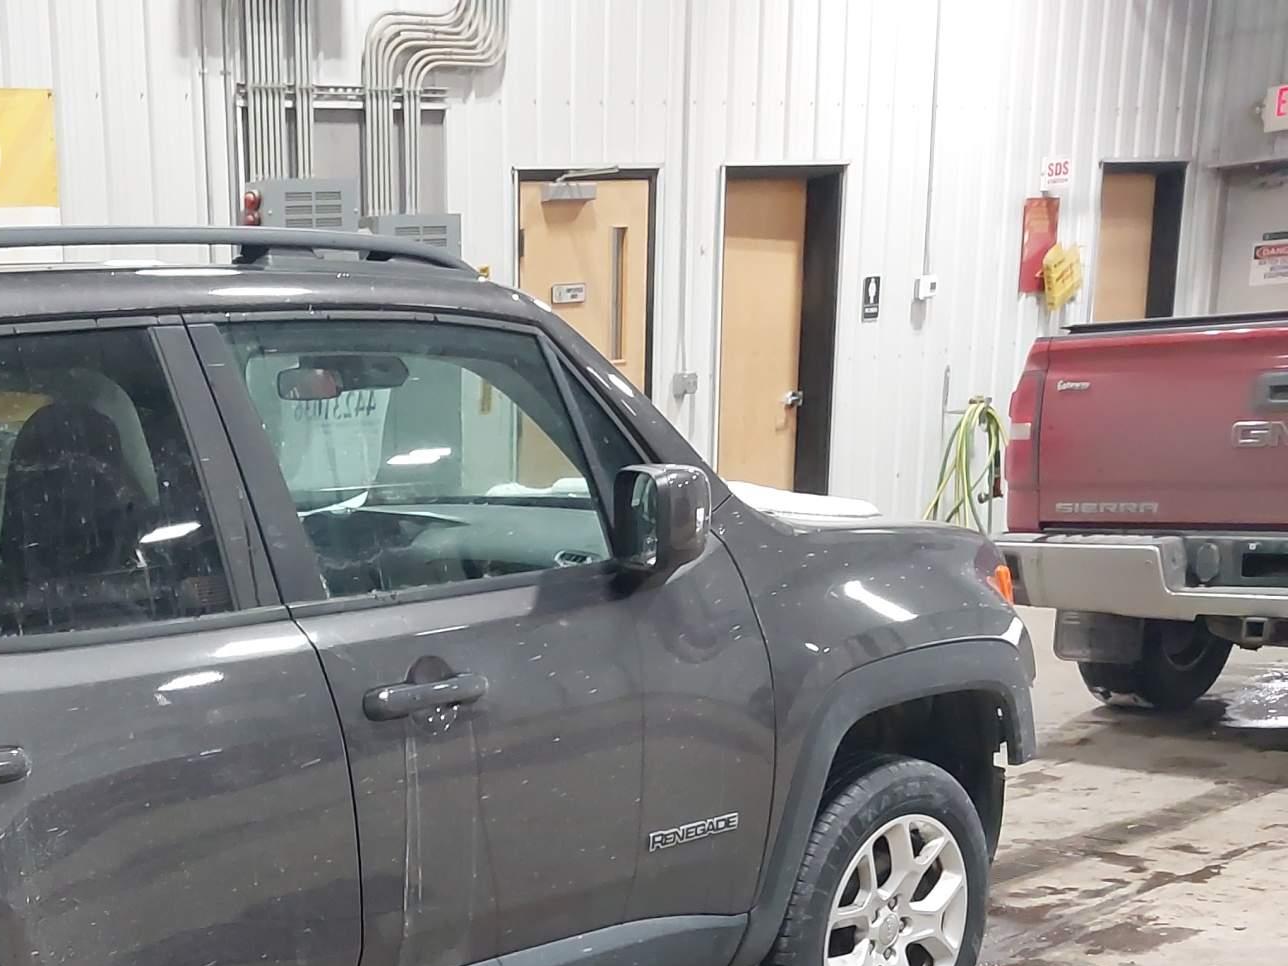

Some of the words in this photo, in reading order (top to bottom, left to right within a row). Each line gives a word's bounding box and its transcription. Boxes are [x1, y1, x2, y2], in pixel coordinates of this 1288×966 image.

[1047, 160, 1069, 177] SDS
[1055, 502, 1159, 513] SIERRA
[649, 812, 739, 852] RENEGADE
